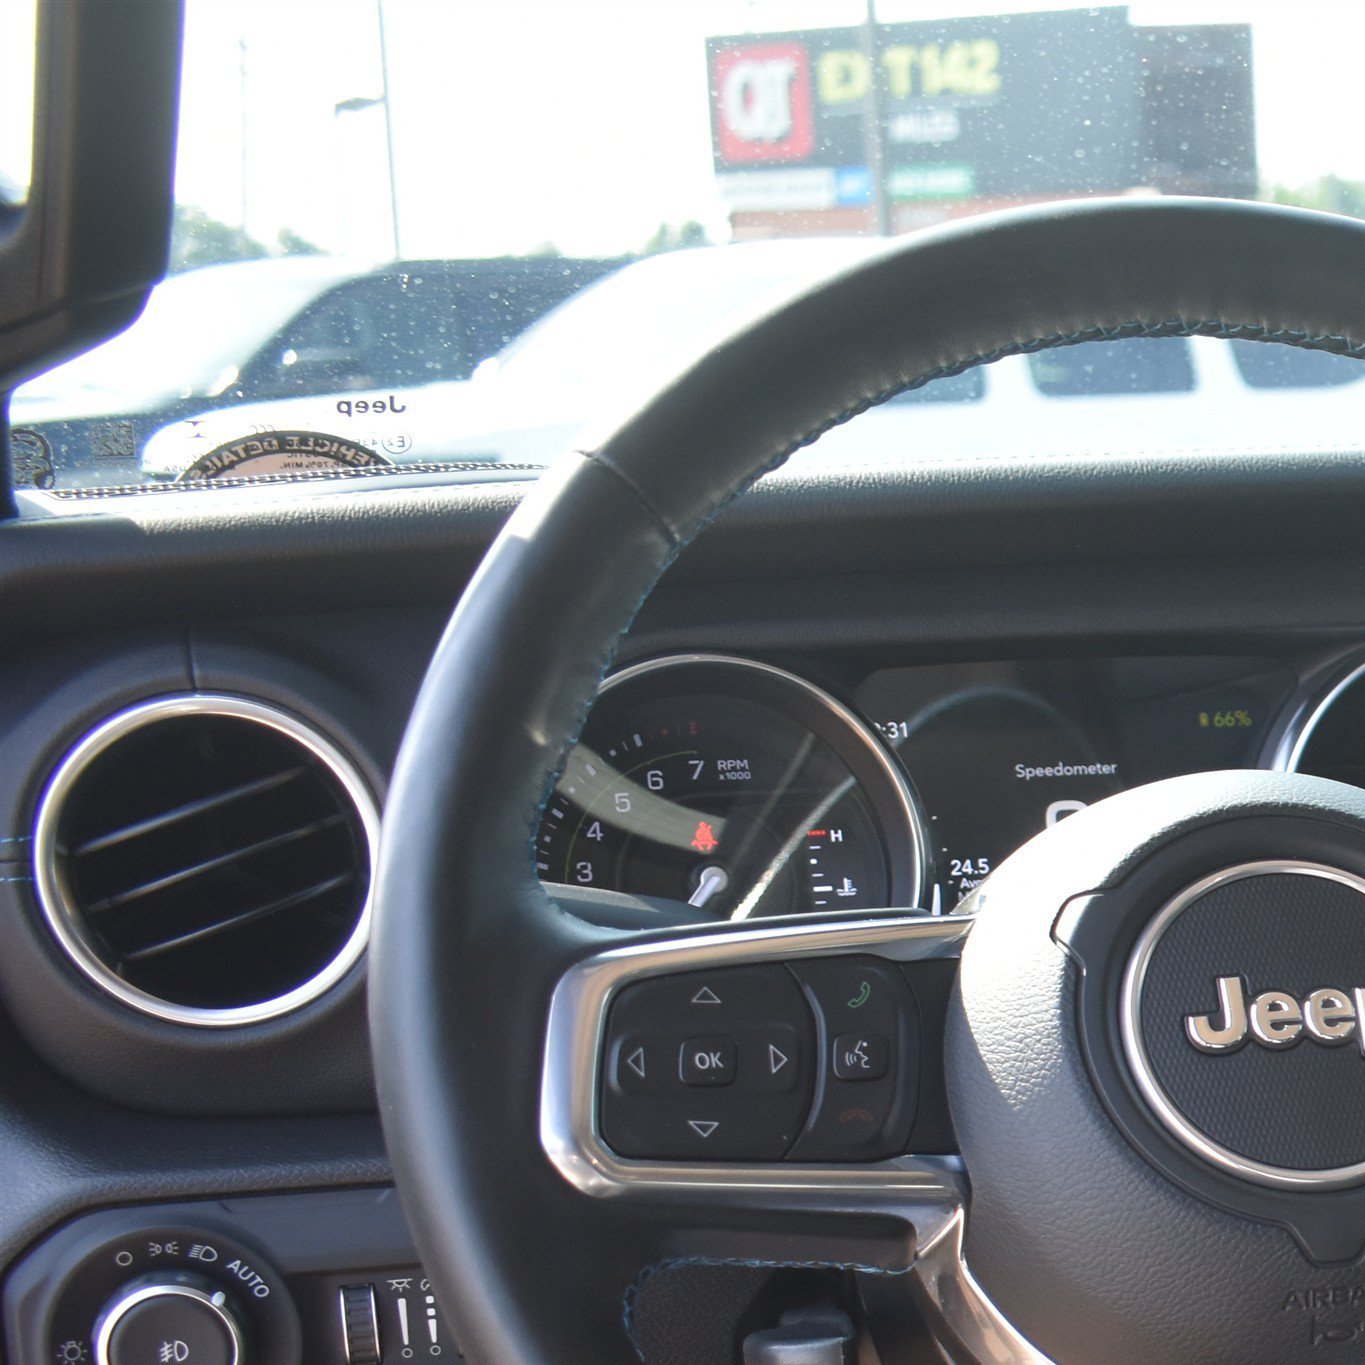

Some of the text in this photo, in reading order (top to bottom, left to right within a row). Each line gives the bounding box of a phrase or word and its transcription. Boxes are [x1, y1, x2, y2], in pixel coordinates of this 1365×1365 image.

[919, 39, 1001, 96] 142
[688, 760, 705, 781] 7
[717, 758, 750, 772] RPM
[718, 770, 752, 781] x1000
[1014, 762, 1118, 780] Speedometer
[647, 769, 665, 790] 6
[614, 792, 632, 813] 5
[586, 821, 604, 842] 4
[829, 829, 843, 843] H
[576, 860, 593, 882] 3
[950, 858, 990, 876] 24.5
[693, 1052, 725, 1070] OK
[226, 1258, 271, 1300] AUTO
